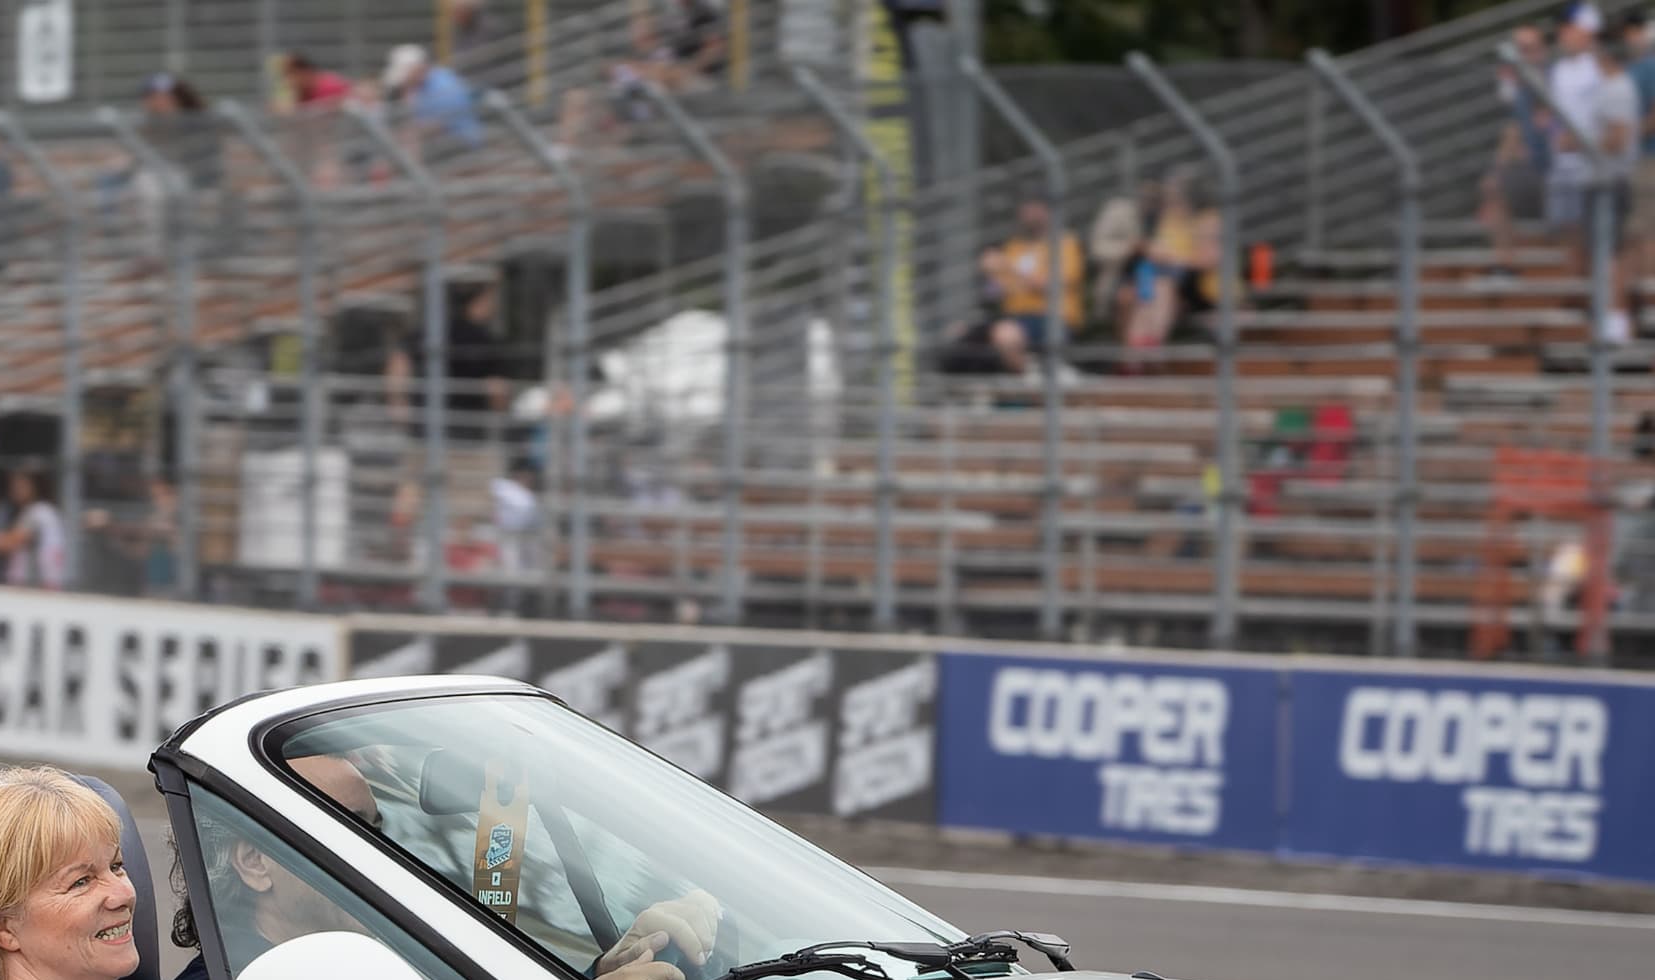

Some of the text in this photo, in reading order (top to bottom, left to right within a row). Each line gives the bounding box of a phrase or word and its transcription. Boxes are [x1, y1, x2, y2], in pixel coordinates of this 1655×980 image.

[989, 667, 1229, 768] COOPER
[1341, 687, 1607, 790] COOPER
[1100, 763, 1223, 834] TIRES
[1462, 786, 1602, 862] TIRES
[478, 890, 512, 905] INFIELD
